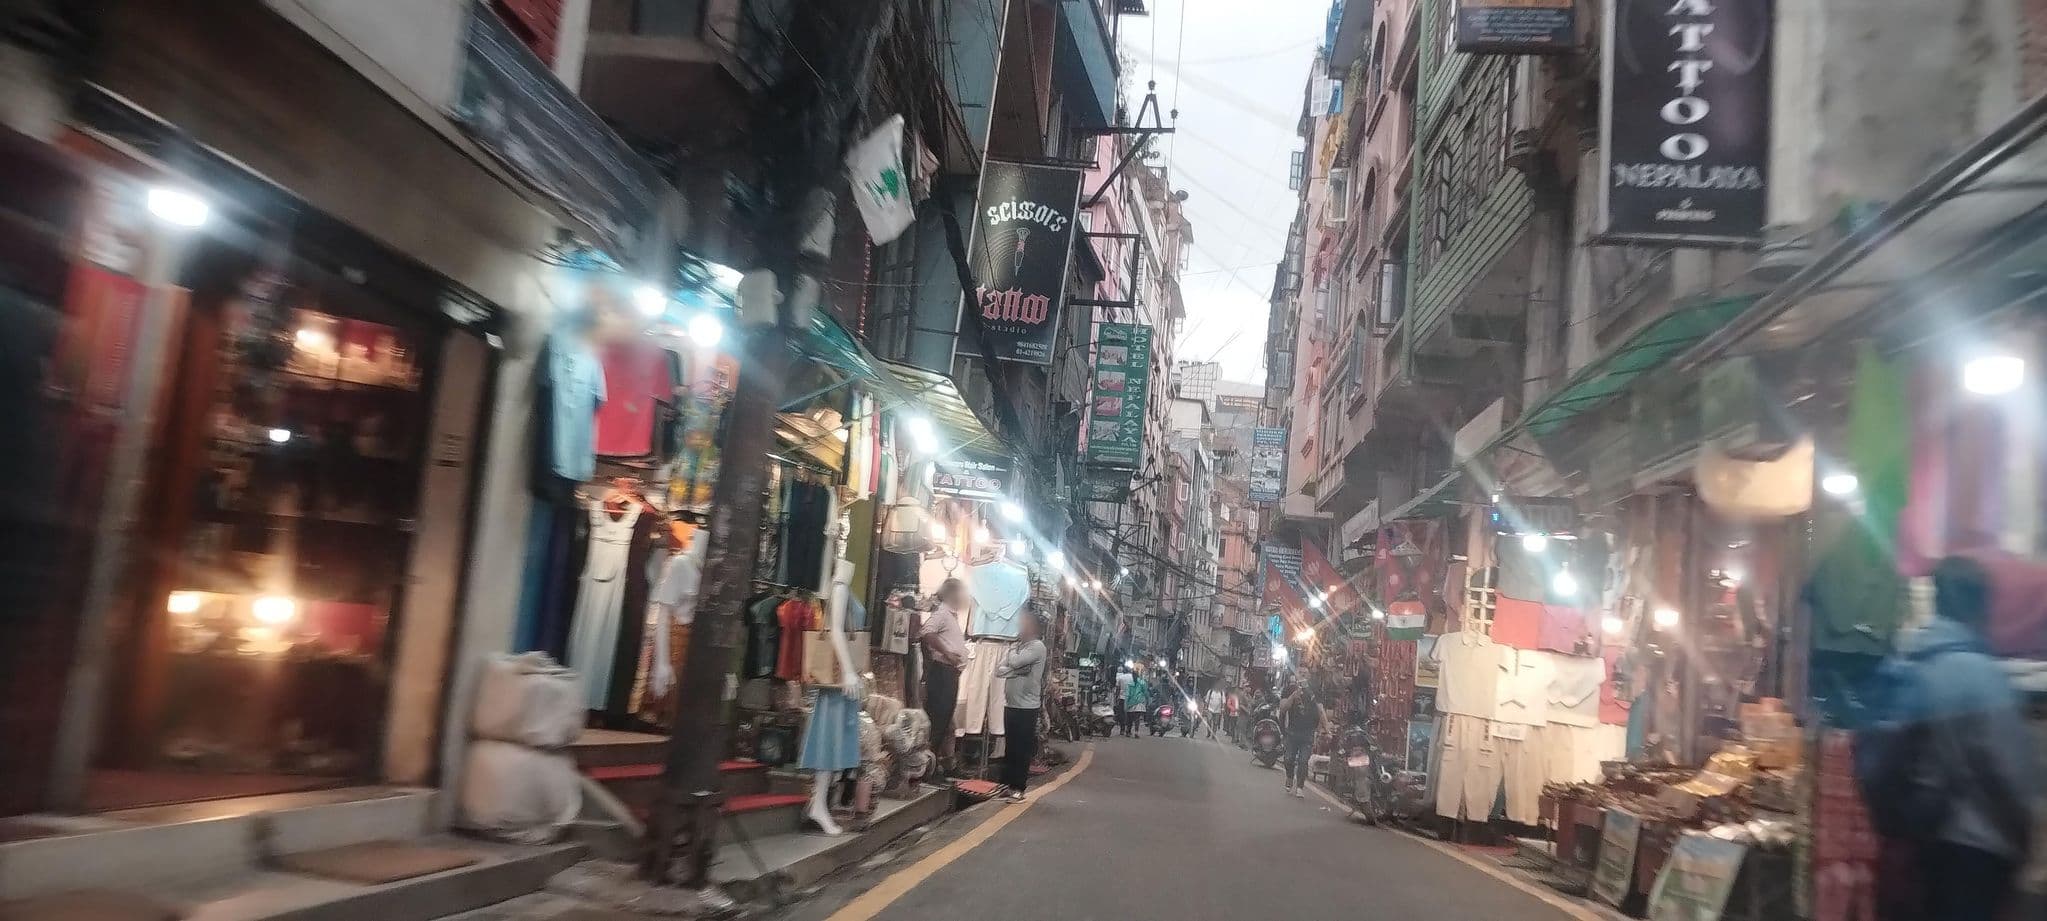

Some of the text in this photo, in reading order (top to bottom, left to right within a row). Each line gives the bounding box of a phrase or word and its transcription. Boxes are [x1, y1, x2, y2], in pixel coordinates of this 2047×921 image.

[986, 196, 1068, 232] scissors
[1130, 327, 1148, 368] HOTEL
[933, 472, 1002, 491] TATTOO
